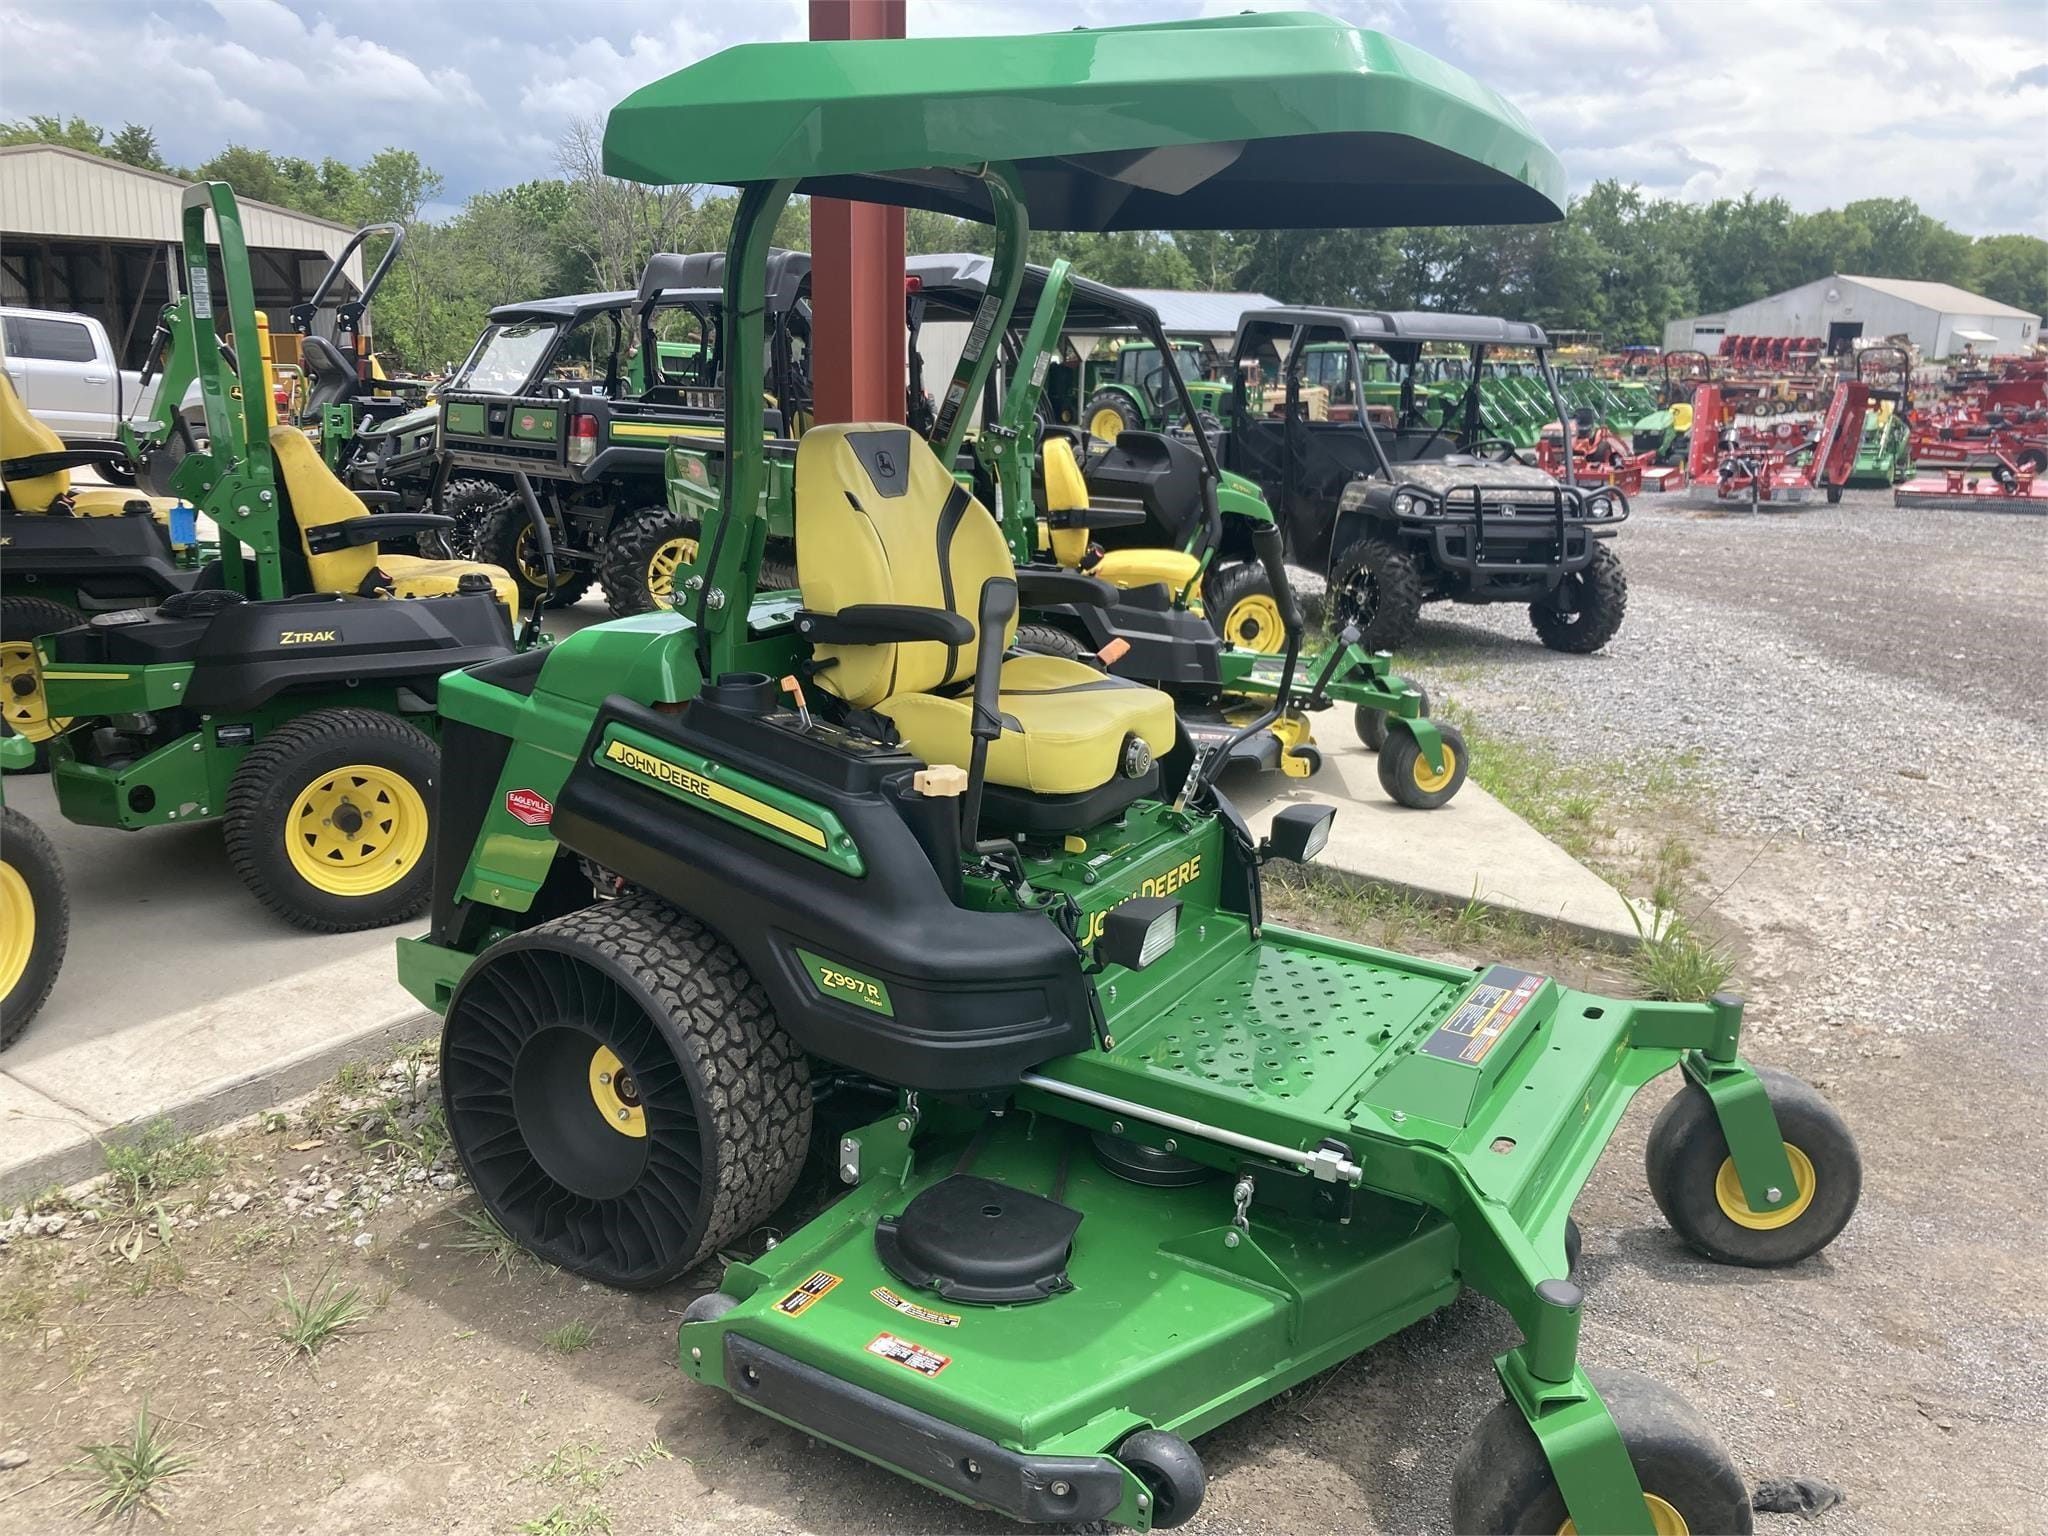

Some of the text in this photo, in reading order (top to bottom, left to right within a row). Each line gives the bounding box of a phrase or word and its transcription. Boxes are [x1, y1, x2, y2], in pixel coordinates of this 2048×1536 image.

[279, 631, 336, 645] ZTRAK
[617, 747, 710, 798] JOHN DEERE
[509, 793, 550, 811] EAGLEVILLE
[1141, 854, 1201, 898] DEERE
